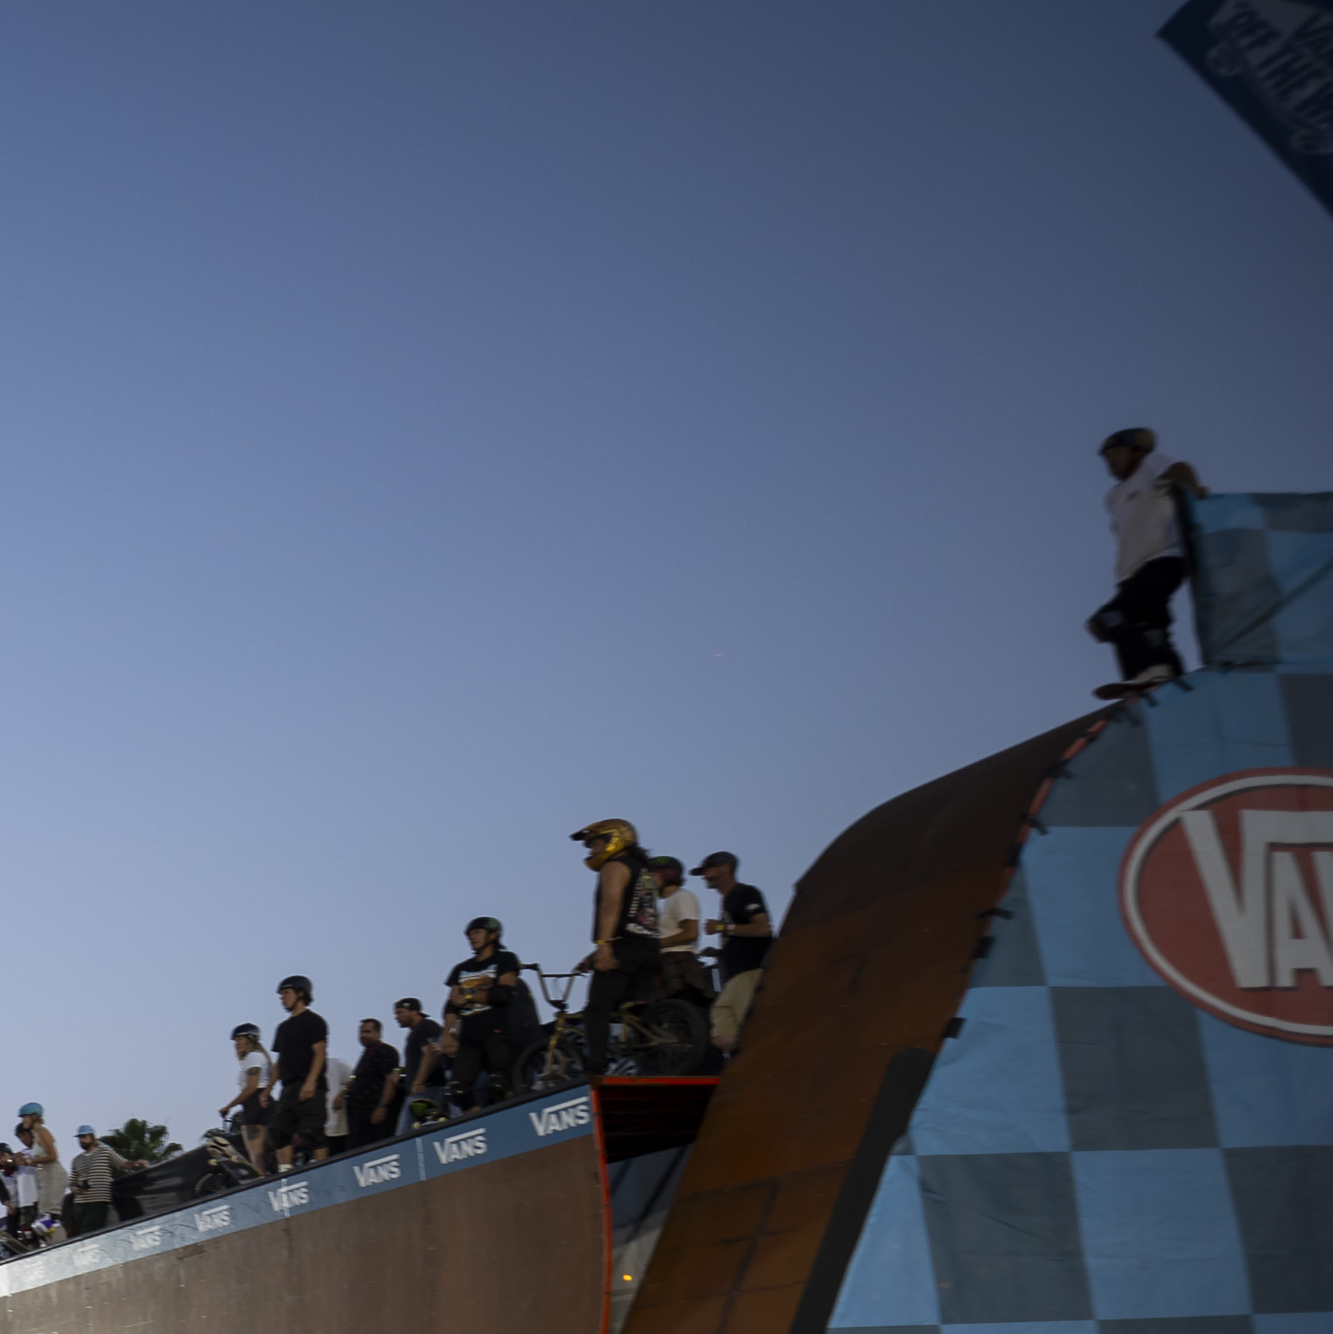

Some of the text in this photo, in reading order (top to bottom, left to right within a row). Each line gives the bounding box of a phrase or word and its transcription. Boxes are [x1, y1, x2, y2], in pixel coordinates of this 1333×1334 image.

[1180, 809, 1333, 990] VA
[529, 1096, 591, 1137] VANS
[433, 1128, 488, 1165] VANS
[353, 1153, 401, 1188] VANS
[267, 1181, 310, 1212] VANS
